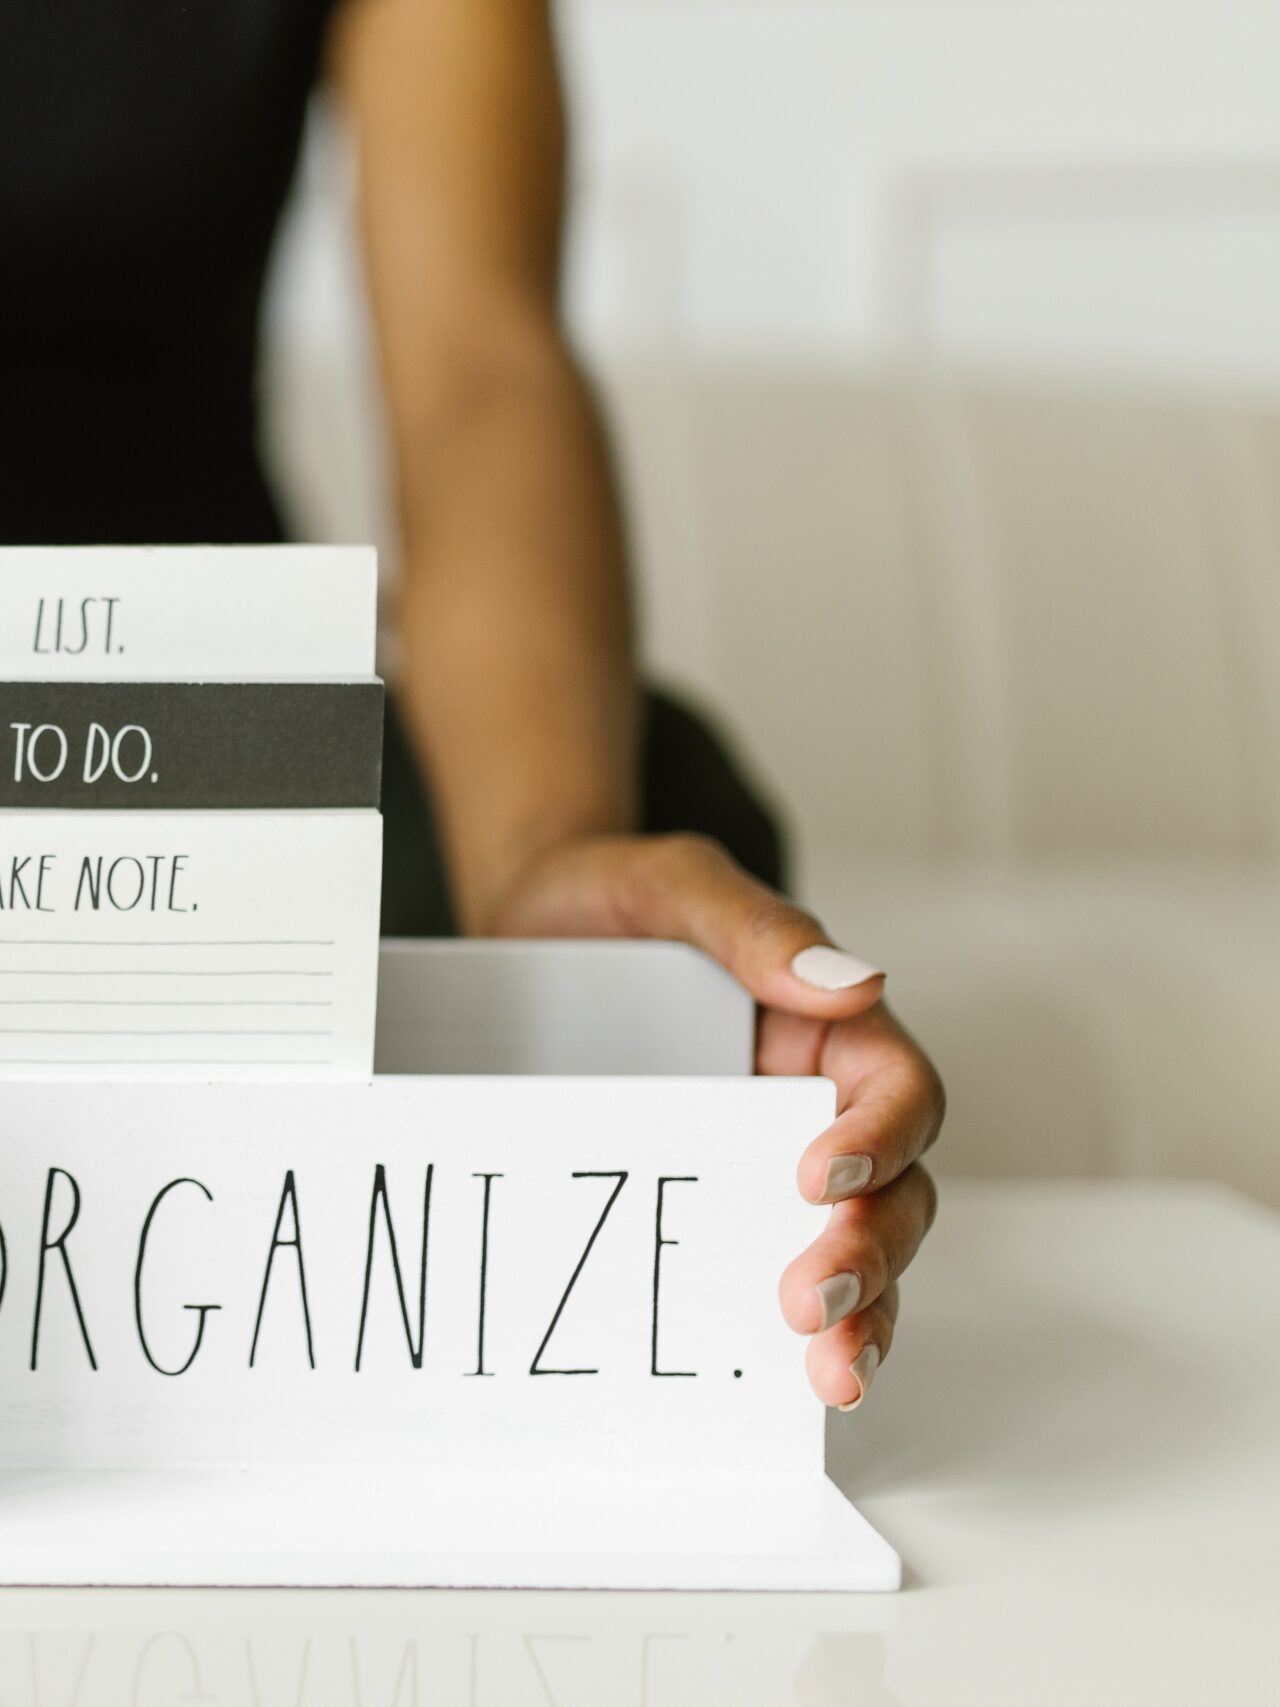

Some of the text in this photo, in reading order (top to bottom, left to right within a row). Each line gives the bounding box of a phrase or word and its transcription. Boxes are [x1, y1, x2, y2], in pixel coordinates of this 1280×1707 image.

[33, 597, 125, 655] LIST.
[10, 722, 159, 783] TO DO.
[74, 855, 198, 912] NOTE.
